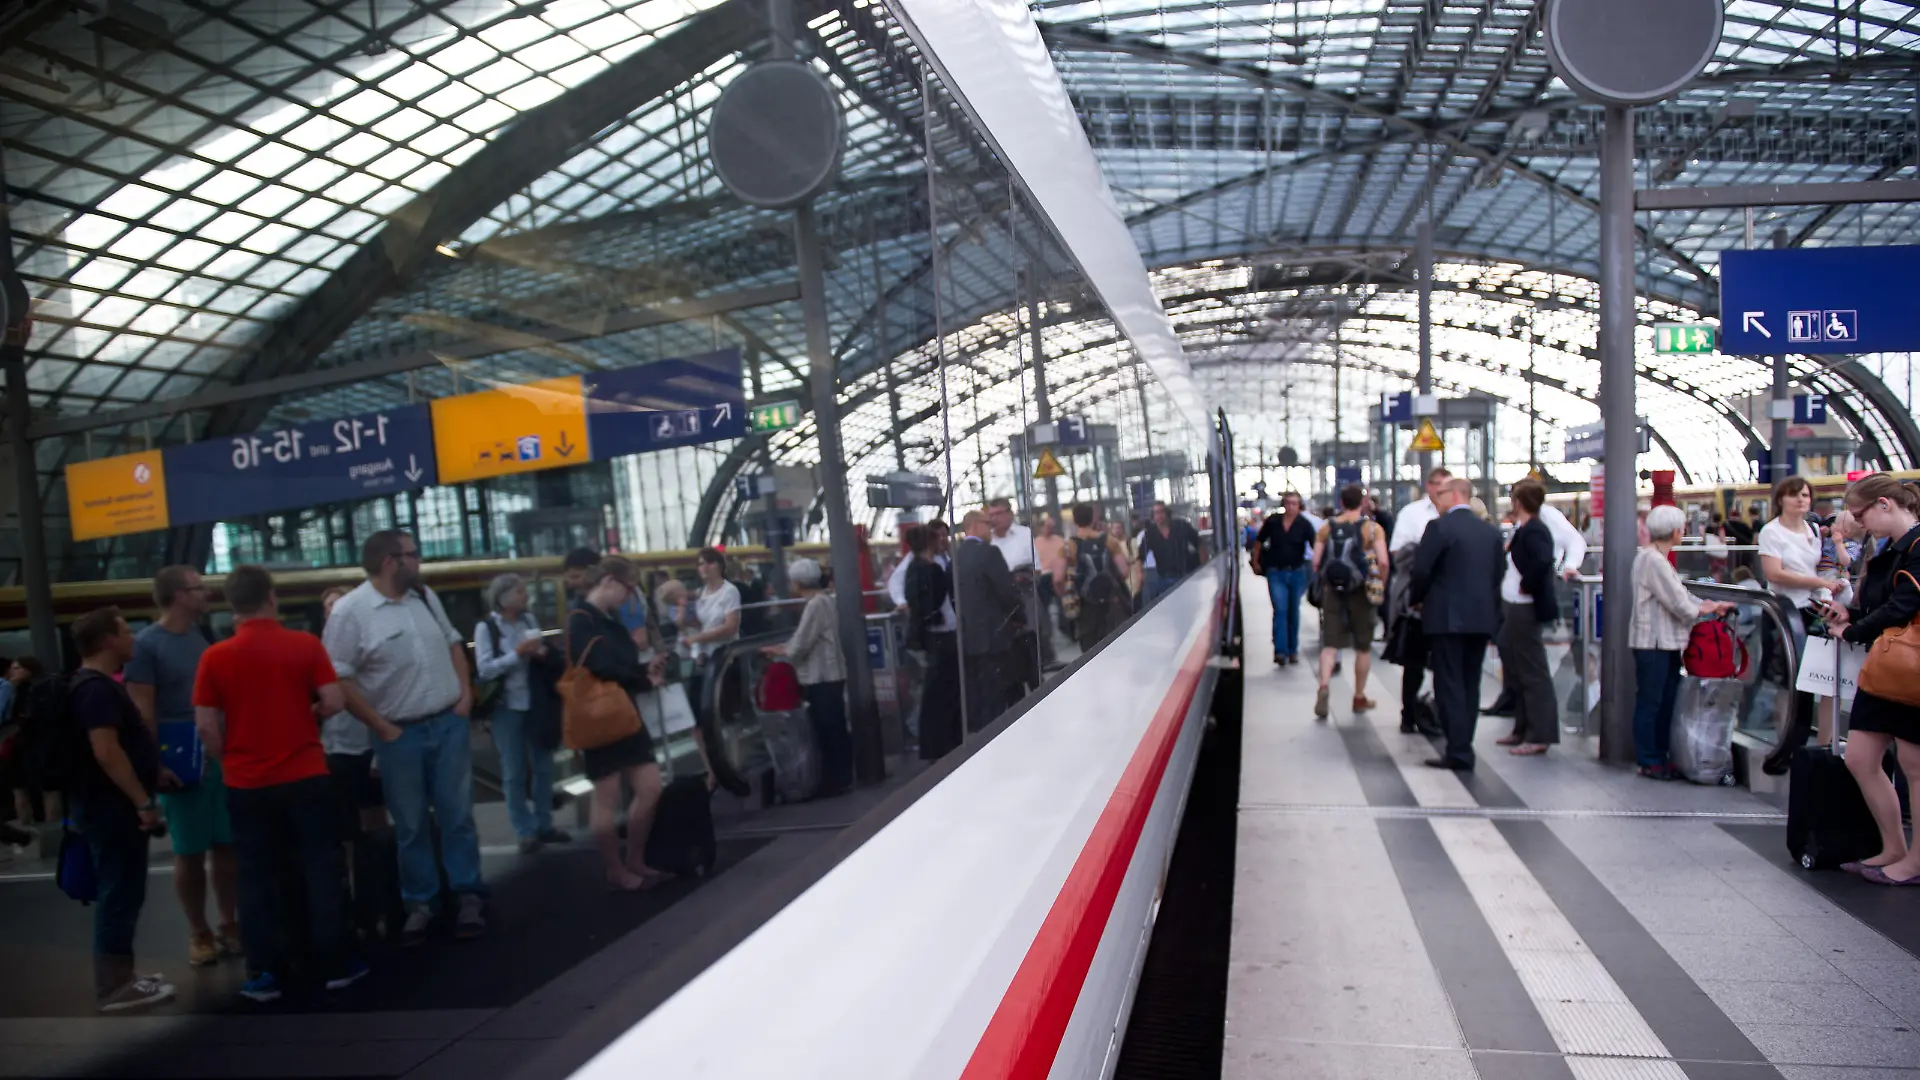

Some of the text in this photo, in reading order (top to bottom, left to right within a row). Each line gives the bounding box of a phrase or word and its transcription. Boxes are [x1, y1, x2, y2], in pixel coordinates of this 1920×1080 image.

[1383, 393, 1400, 417] F
[1807, 394, 1823, 419] F
[1809, 672, 1854, 687] PANDRA
